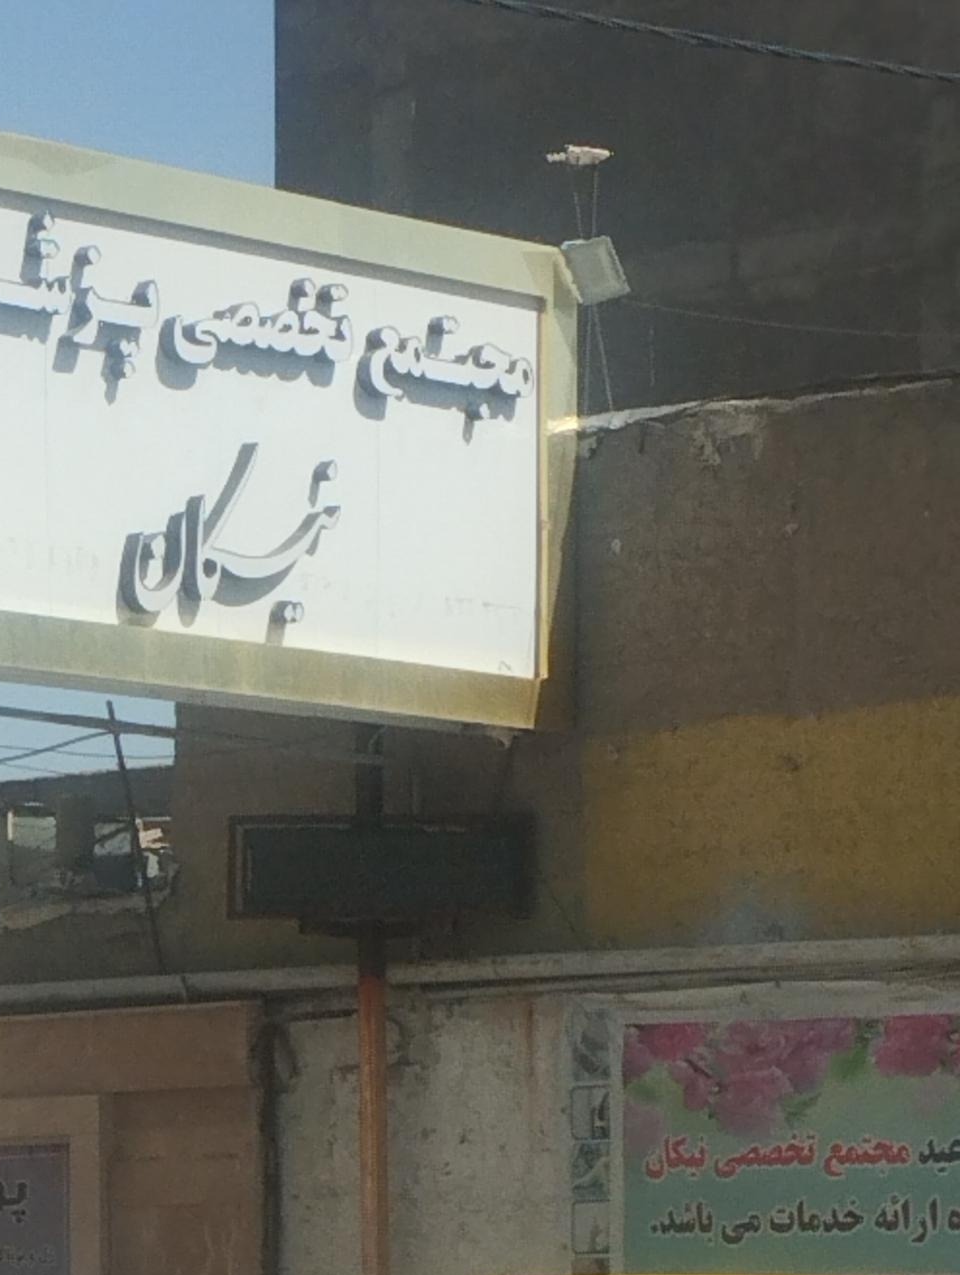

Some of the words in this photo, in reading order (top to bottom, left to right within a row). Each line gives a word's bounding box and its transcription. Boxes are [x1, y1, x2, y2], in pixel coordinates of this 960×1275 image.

[170, 277, 353, 366] تخصصی
[367, 315, 535, 422] مجتمع
[132, 442, 341, 627] نیکان
[645, 1137, 708, 1180] نیکان
[714, 1136, 817, 1178] تخصصی
[823, 1137, 911, 1177] مجتمع
[721, 1212, 762, 1243] می
[768, 1200, 865, 1234] خدمات
